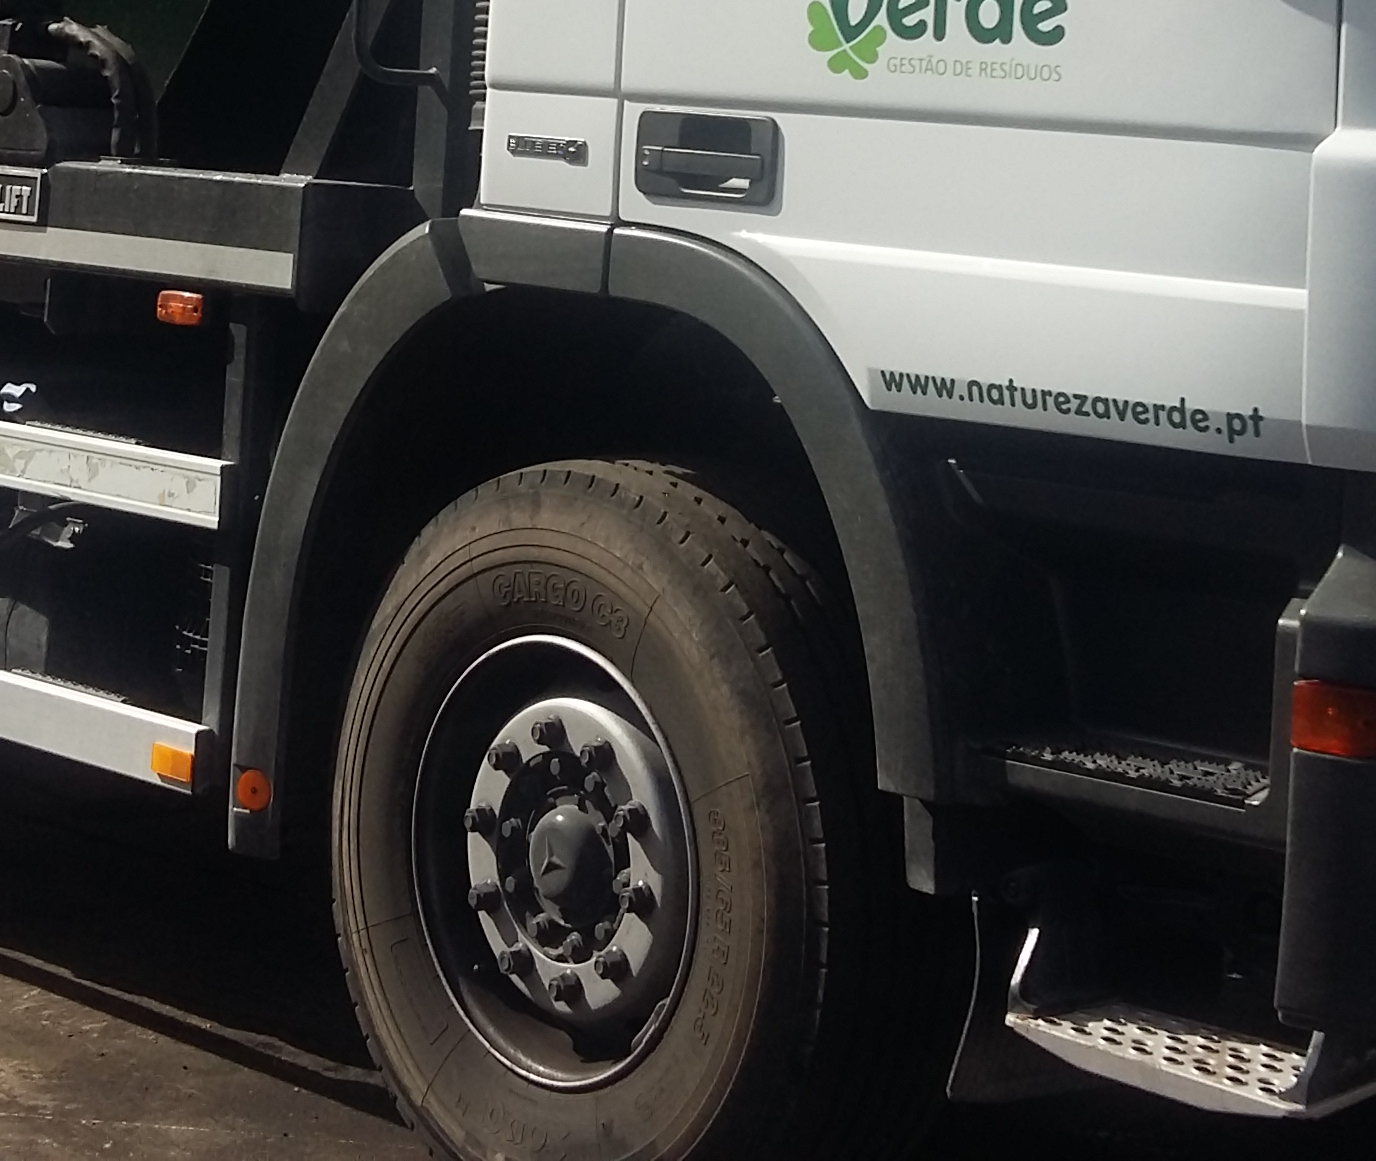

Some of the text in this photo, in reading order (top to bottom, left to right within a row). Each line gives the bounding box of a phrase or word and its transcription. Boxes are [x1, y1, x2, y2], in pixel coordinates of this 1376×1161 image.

[886, 55, 1063, 83] GESTÃO DE RESÍDUOS
[880, 369, 1265, 443] www.naturezaverde.pt
[491, 569, 588, 613] CARGO
